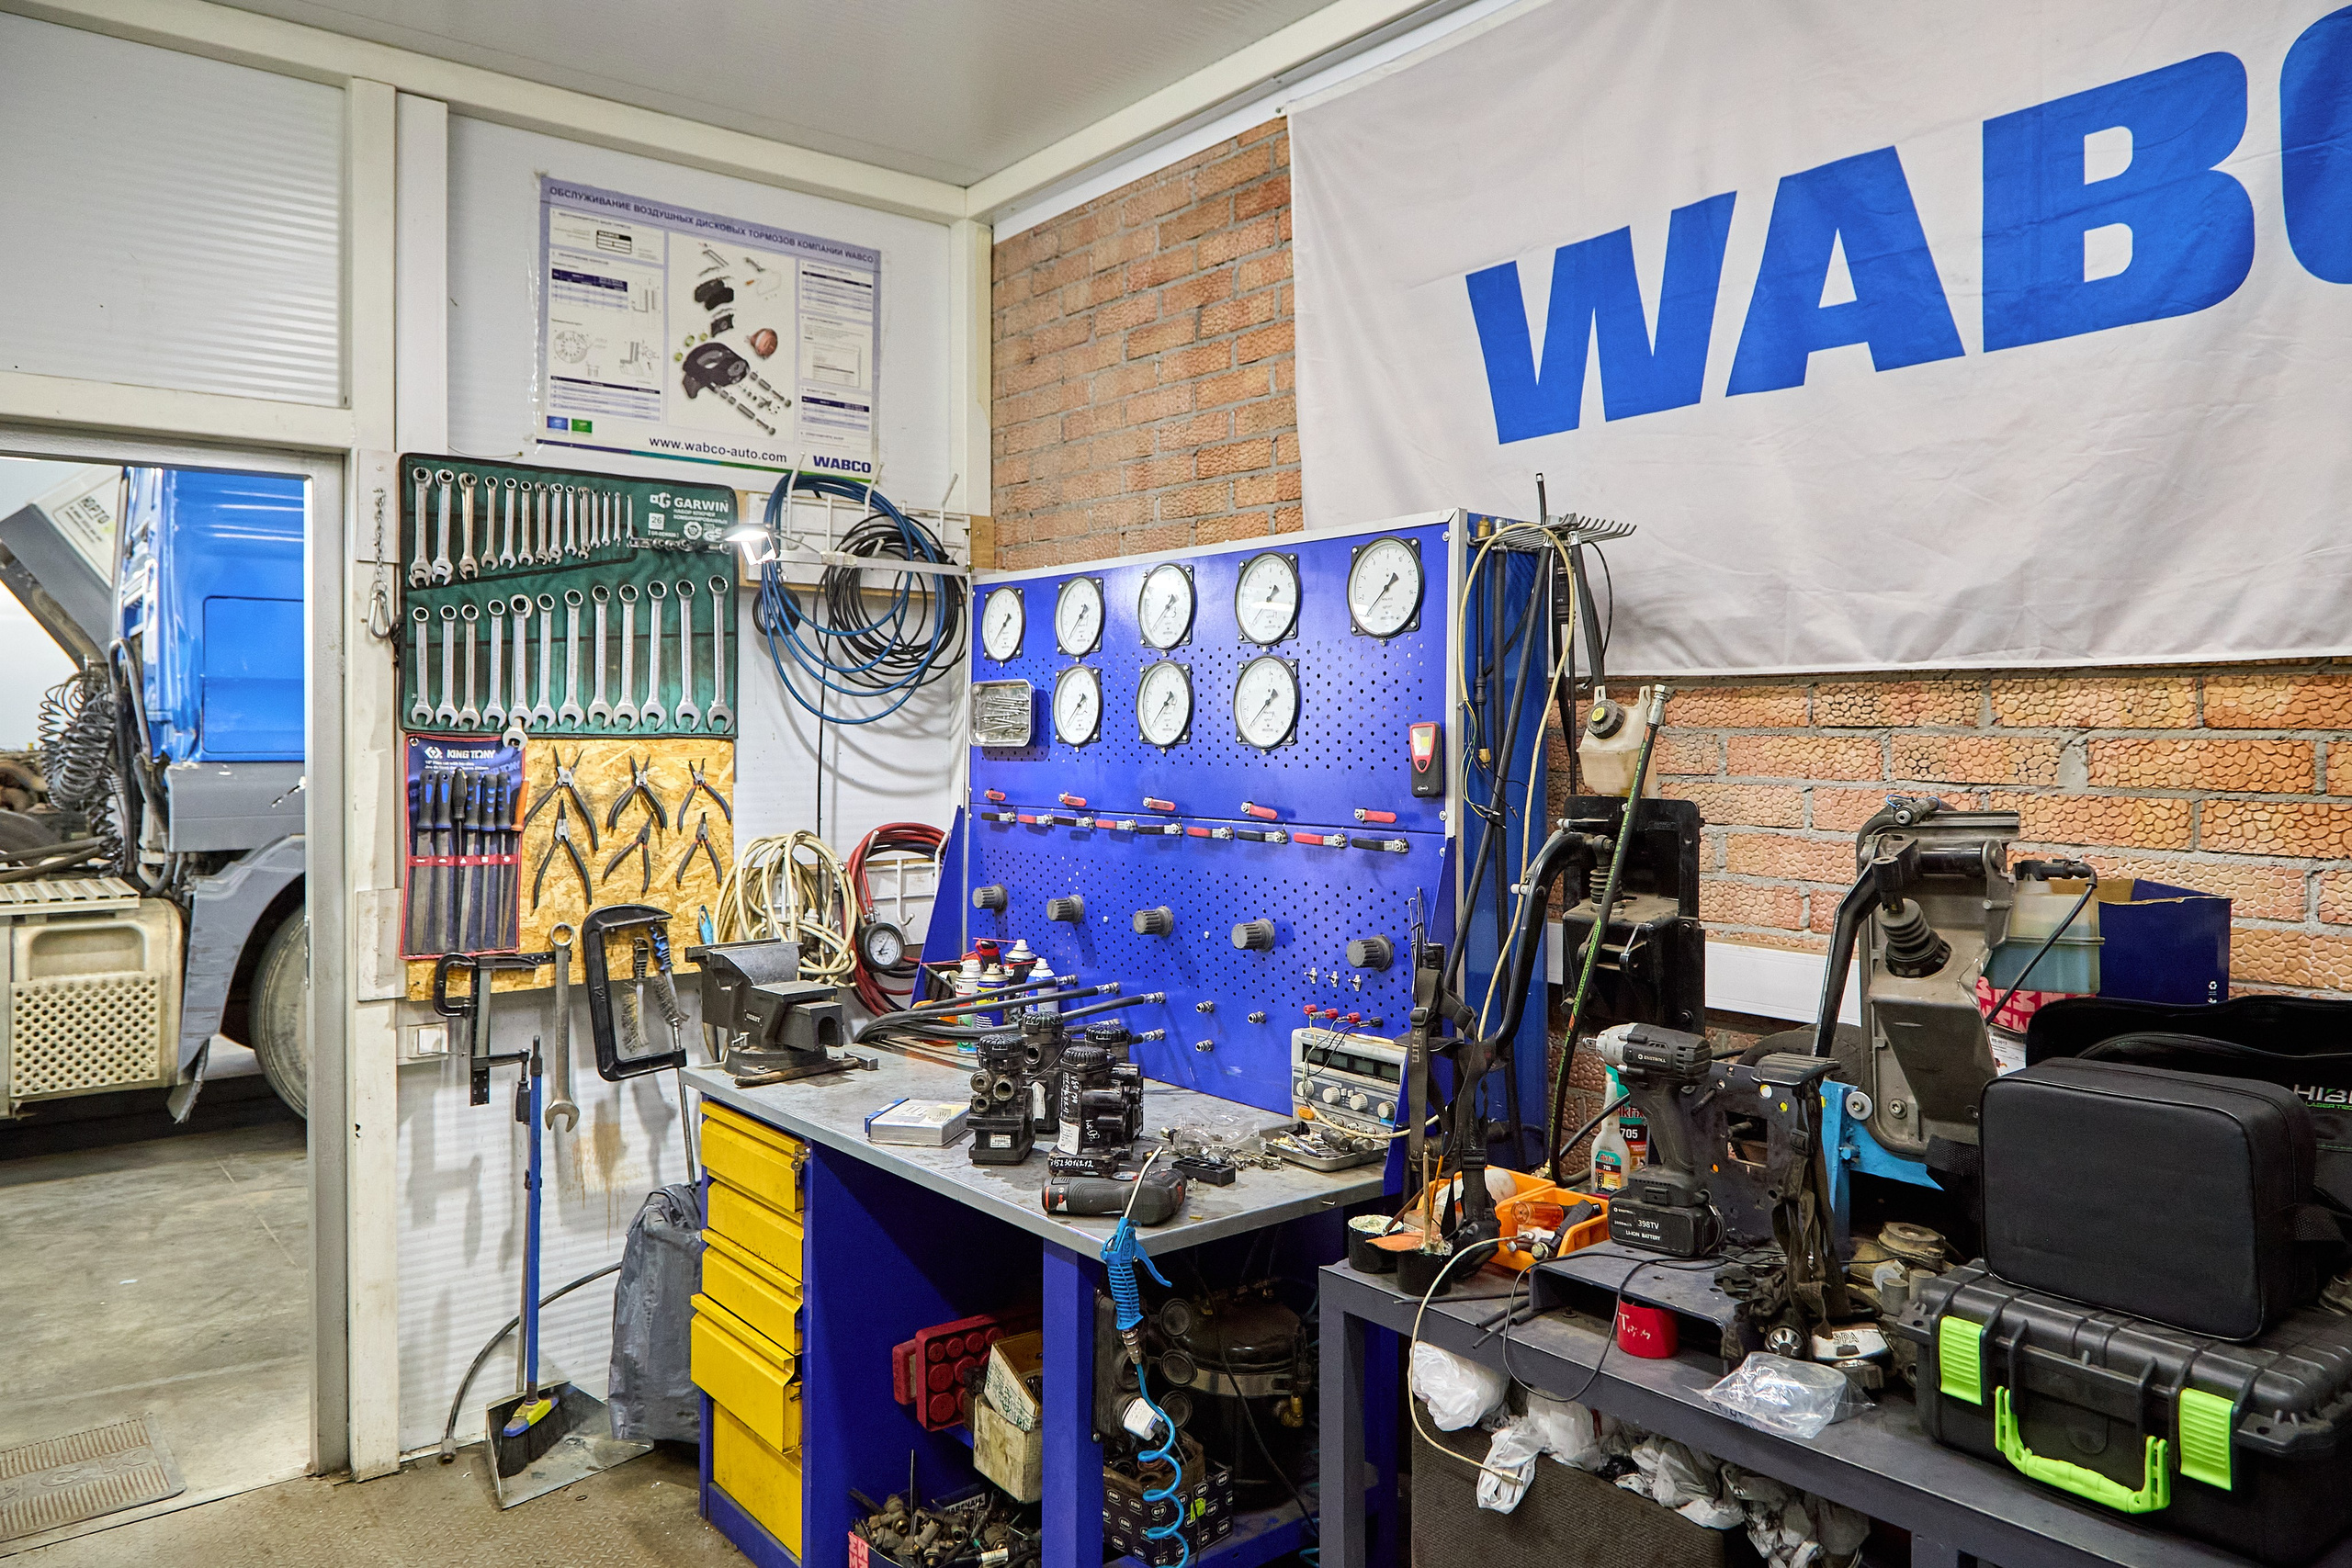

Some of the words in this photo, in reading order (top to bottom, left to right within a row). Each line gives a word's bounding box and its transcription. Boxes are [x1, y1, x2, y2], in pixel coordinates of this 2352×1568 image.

[549, 186, 631, 210] ОБСЛУЖИВАНИЕ
[633, 204, 694, 224] ВОЗДУШНЫХ
[695, 218, 746, 236] ДИСКОВЫХ
[749, 230, 796, 246] ТОРМОЗОВ
[797, 241, 844, 257] КОМПАНИИ
[844, 251, 874, 264] WABCO
[1465, 4, 2352, 445] WAB
[649, 436, 787, 464] www.wabco-auto.com
[813, 455, 871, 473] WABCO
[673, 497, 729, 513] GARWIN
[651, 516, 662, 525] 26
[447, 749, 469, 759] KING
[470, 749, 496, 759] TONY
[1620, 1128, 1638, 1139] 705
[1637, 1219, 1659, 1230] 398TV
[1641, 1233, 1661, 1241] BATTERY
[1833, 1332, 1860, 1345] ЭРА
